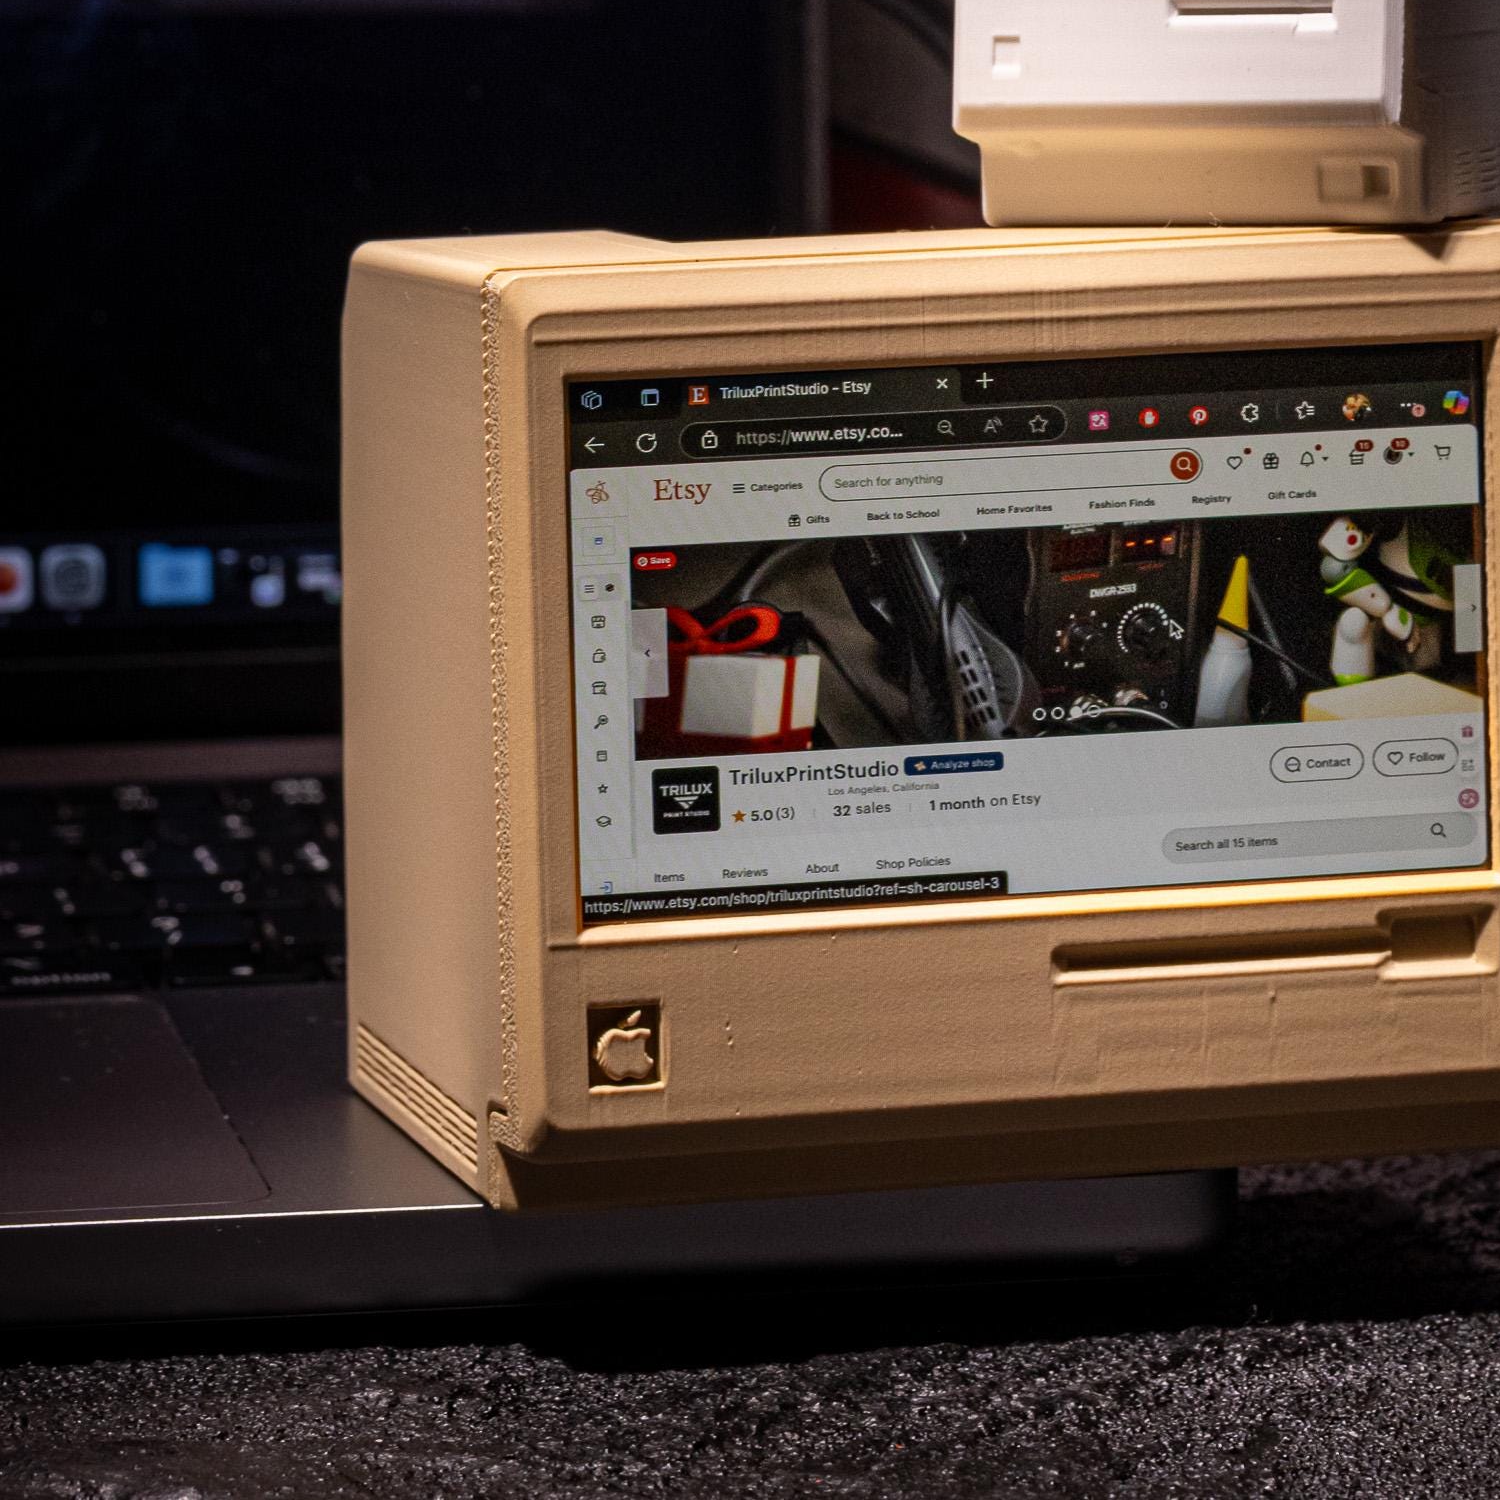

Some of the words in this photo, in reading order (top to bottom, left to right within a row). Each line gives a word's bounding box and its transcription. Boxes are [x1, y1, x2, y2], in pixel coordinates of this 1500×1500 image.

[720, 383, 828, 399] TriluxPrintStudio
[842, 381, 871, 395] Etsy
[751, 481, 803, 494] Categories
[834, 476, 873, 489] Search
[876, 476, 892, 487] for
[896, 473, 944, 488] anything
[653, 479, 712, 505] Etsy
[1268, 491, 1286, 501] Gift
[1289, 488, 1317, 499] Cards
[1089, 499, 1125, 510] Fashion
[1127, 498, 1155, 508] Finds
[1192, 494, 1232, 506] Registry
[867, 512, 890, 521] Back
[893, 511, 903, 520] to
[906, 508, 940, 520] School
[977, 506, 1004, 514] Home
[1008, 502, 1052, 514] Favorites
[807, 514, 830, 525] Gifts
[1306, 757, 1351, 769] Contact
[1409, 751, 1445, 764] Follow
[930, 759, 969, 771] Analyze
[971, 758, 995, 770] shop
[730, 761, 898, 785] TriluxPrintStudio
[659, 782, 712, 796] TRILUX
[828, 787, 844, 795] Los
[848, 784, 889, 796] Angeles,
[892, 781, 939, 792] California
[930, 800, 935, 811] 1
[940, 796, 985, 810] month
[990, 797, 1008, 807] on
[1012, 793, 1041, 808] Etsy
[751, 809, 773, 822] 5.0
[776, 807, 795, 822] (3)
[833, 805, 851, 817] 32
[855, 801, 891, 814] sales
[1175, 840, 1213, 851] Search
[1216, 838, 1230, 849] all
[1232, 837, 1244, 848] 15
[1248, 835, 1278, 847] items
[805, 862, 839, 874] About
[876, 858, 905, 870] Shop
[908, 855, 951, 868] Policies
[654, 871, 685, 883] Items
[722, 867, 768, 878] Reviews
